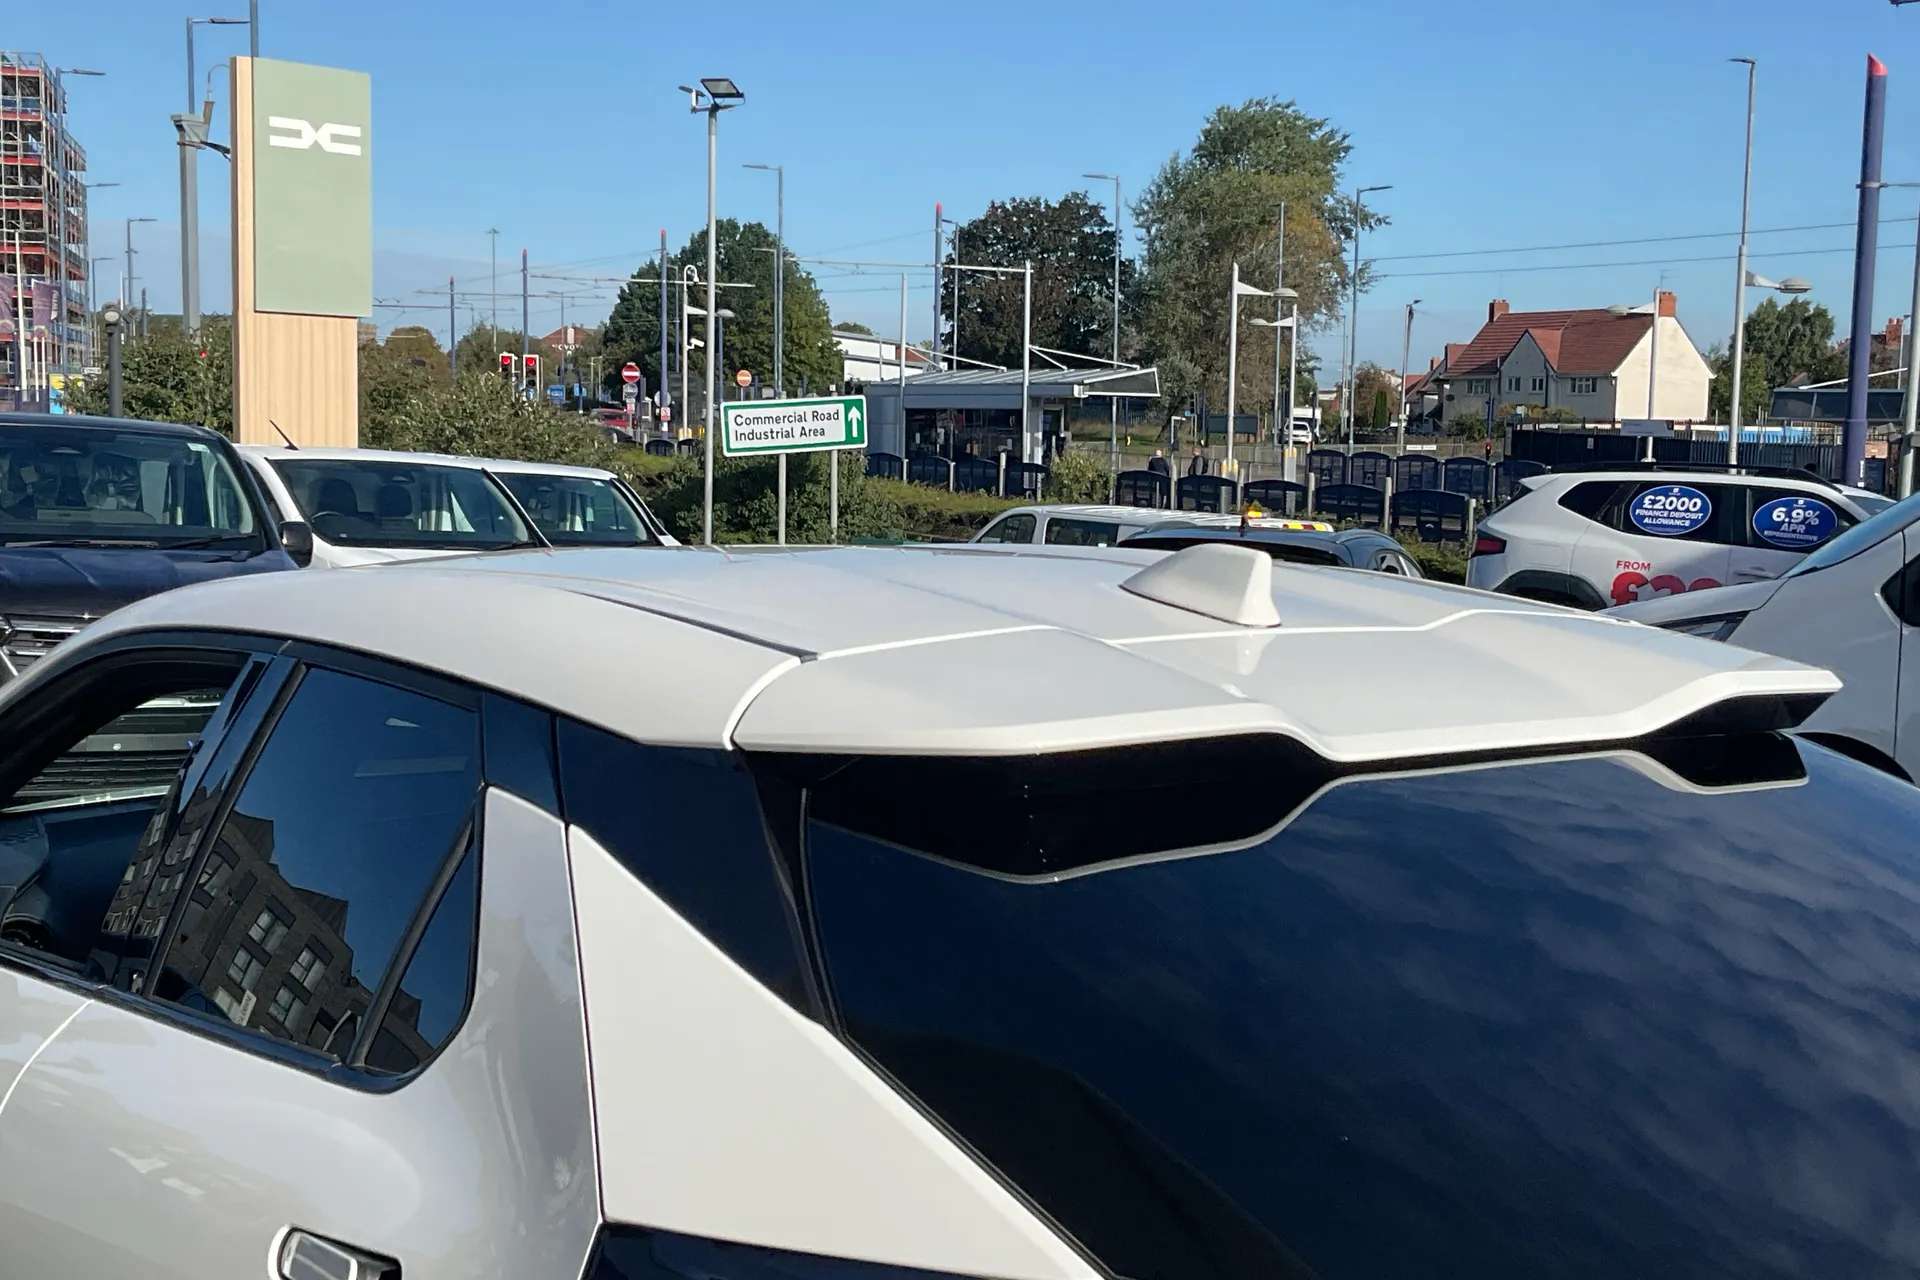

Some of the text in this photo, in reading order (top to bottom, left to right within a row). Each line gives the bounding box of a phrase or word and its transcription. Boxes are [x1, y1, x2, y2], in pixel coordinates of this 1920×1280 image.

[734, 409, 840, 426] Commercial Road
[735, 426, 825, 441] Industrial Area
[1642, 495, 1702, 512] £2000
[1635, 508, 1704, 519] FINANCE DEPOSIT
[1772, 507, 1820, 525] 6.9%
[1643, 517, 1691, 527] ALLOWANCE
[1780, 523, 1806, 533] APR
[1616, 560, 1651, 571] FROM
